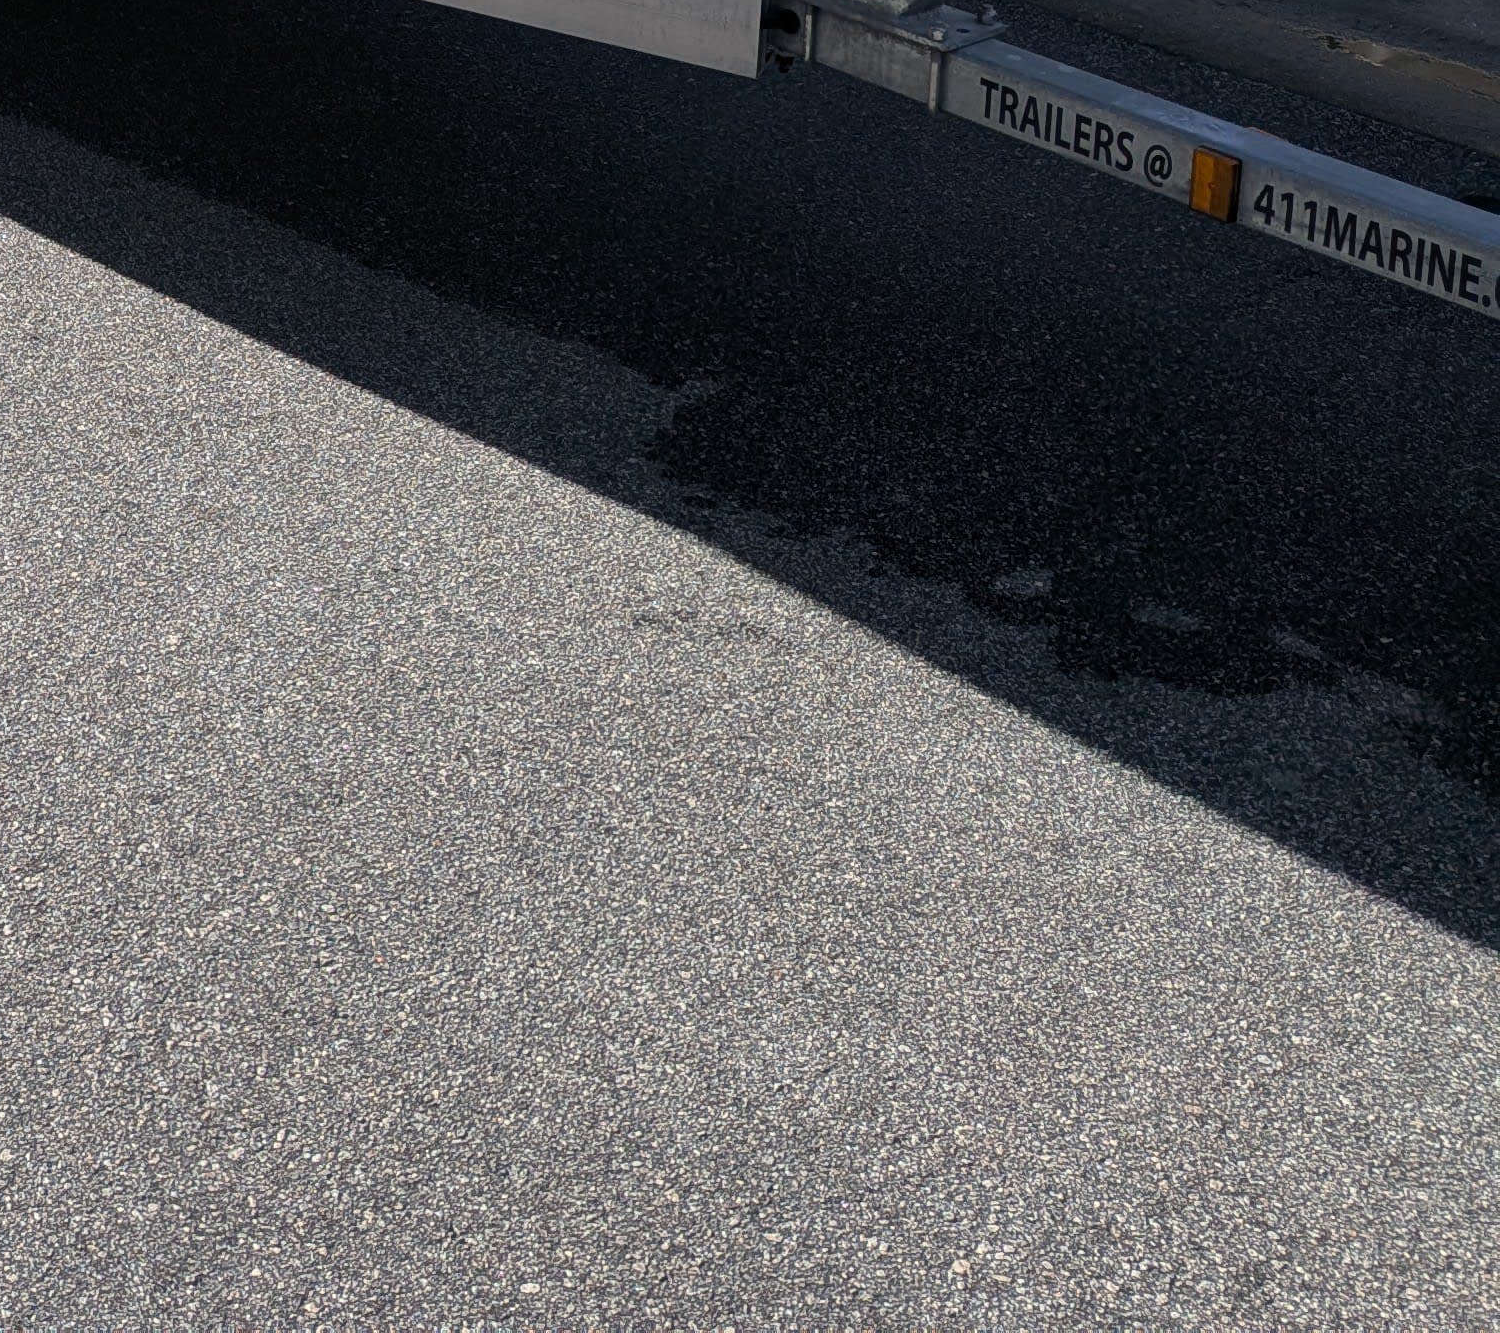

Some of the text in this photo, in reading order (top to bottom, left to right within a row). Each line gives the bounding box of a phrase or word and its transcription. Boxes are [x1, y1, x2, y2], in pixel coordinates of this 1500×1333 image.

[979, 77, 1500, 309] TRAILERS @ 411MARINE.
